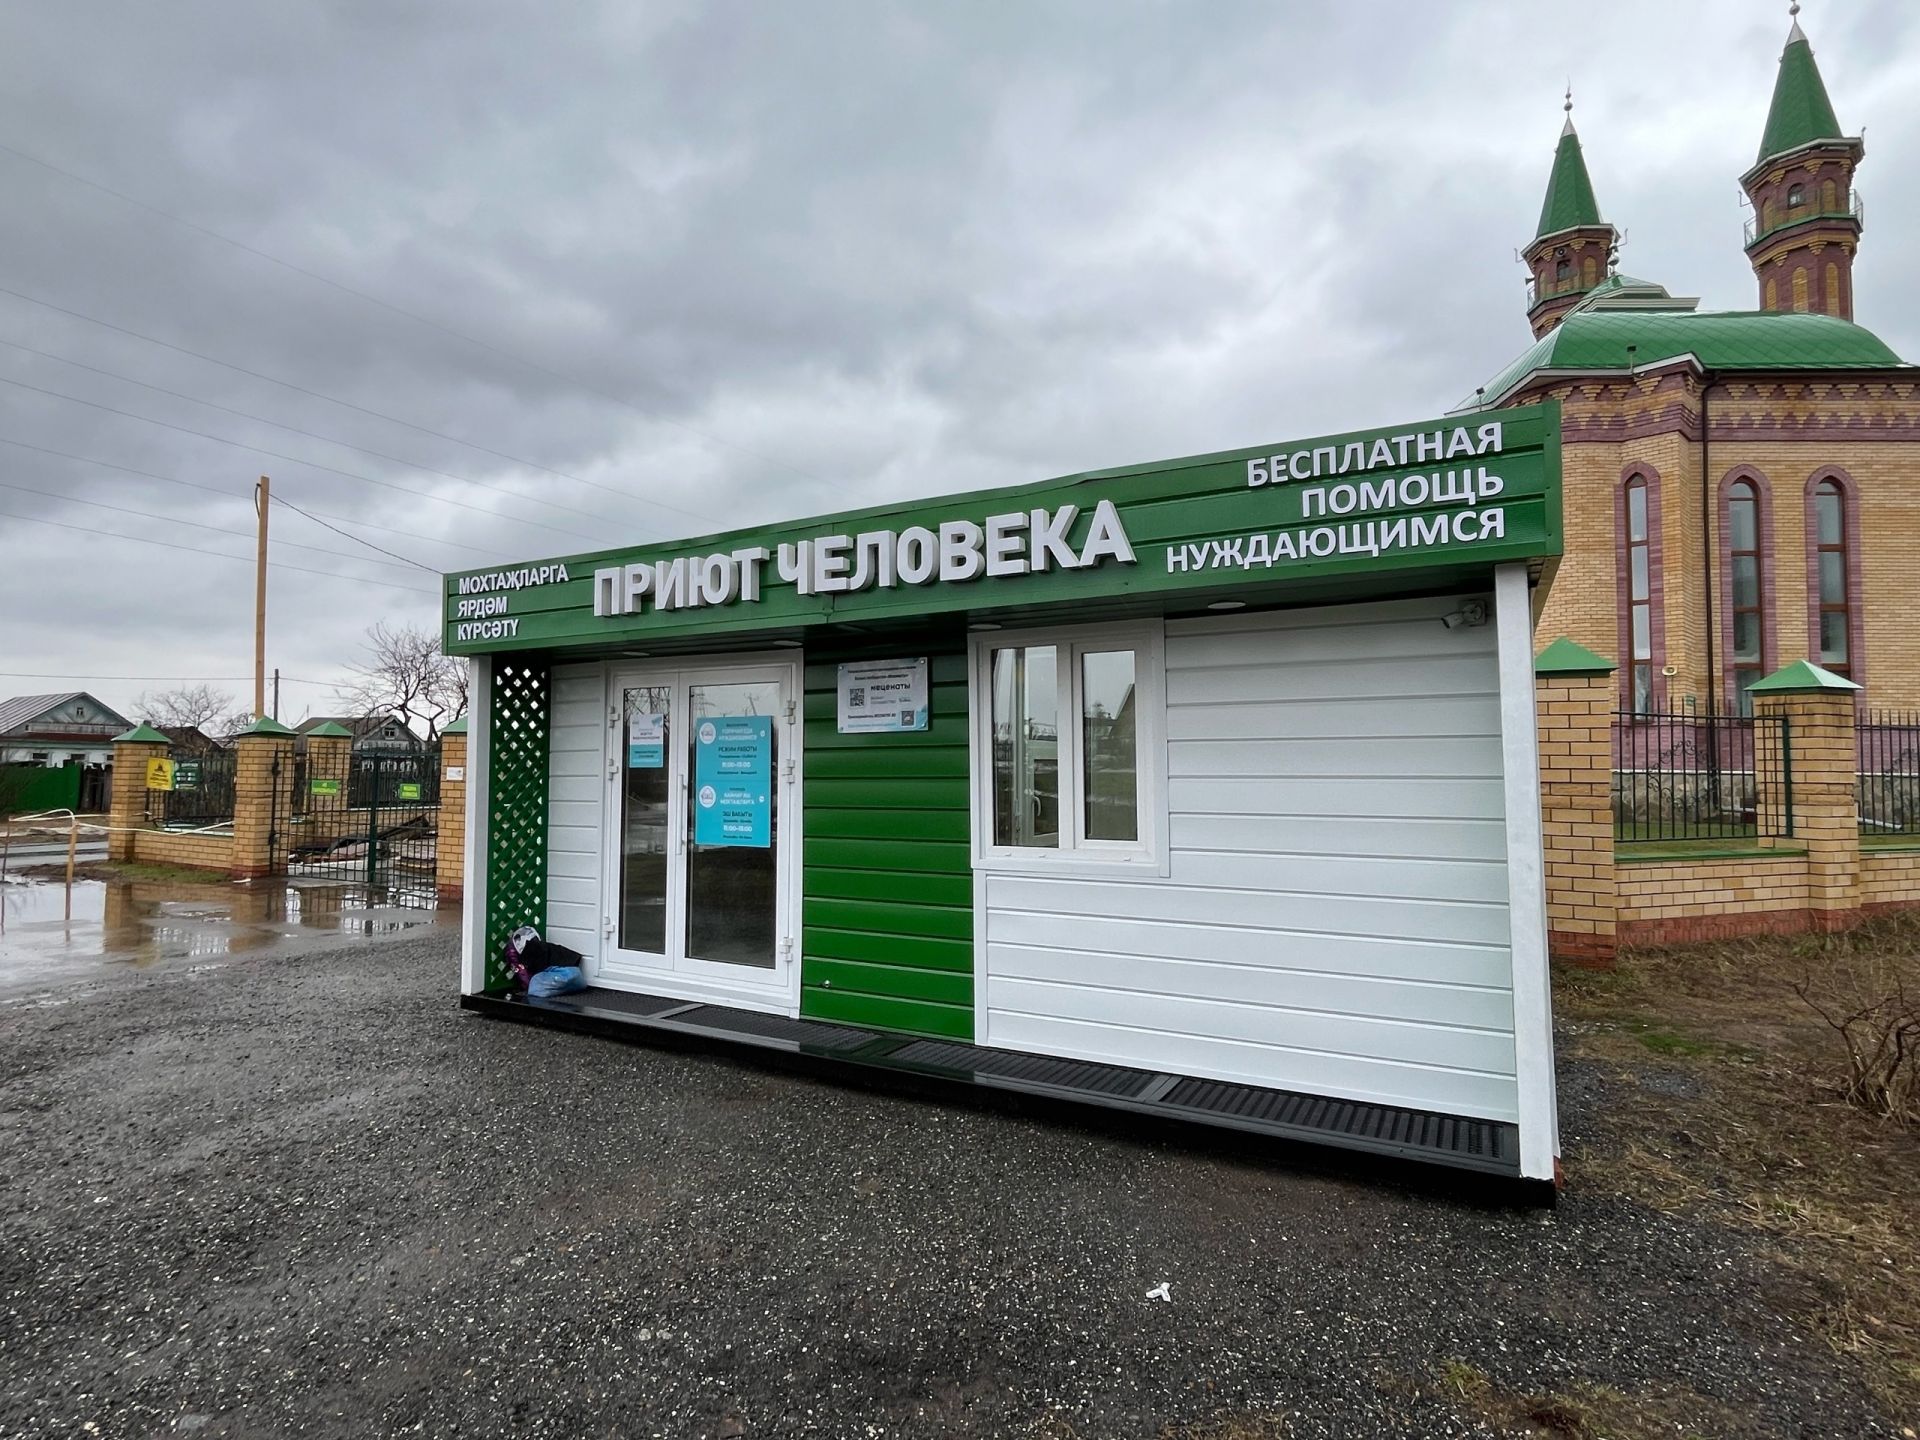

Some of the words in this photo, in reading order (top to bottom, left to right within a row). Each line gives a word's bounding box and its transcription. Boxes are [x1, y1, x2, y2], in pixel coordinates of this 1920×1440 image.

[1247, 422, 1503, 487] БЕСПЛАТНАЯ
[1301, 467, 1504, 518] ПОМОЩЬ
[593, 547, 770, 617] ПРИЮТ
[777, 500, 1138, 596] ЧЕЛОВЕКА
[1166, 508, 1505, 573] НУЖДАЮЩИМСЯ
[457, 596, 508, 619] ЯРДӘМ
[458, 563, 569, 595] МОХТАҖЛАРГА
